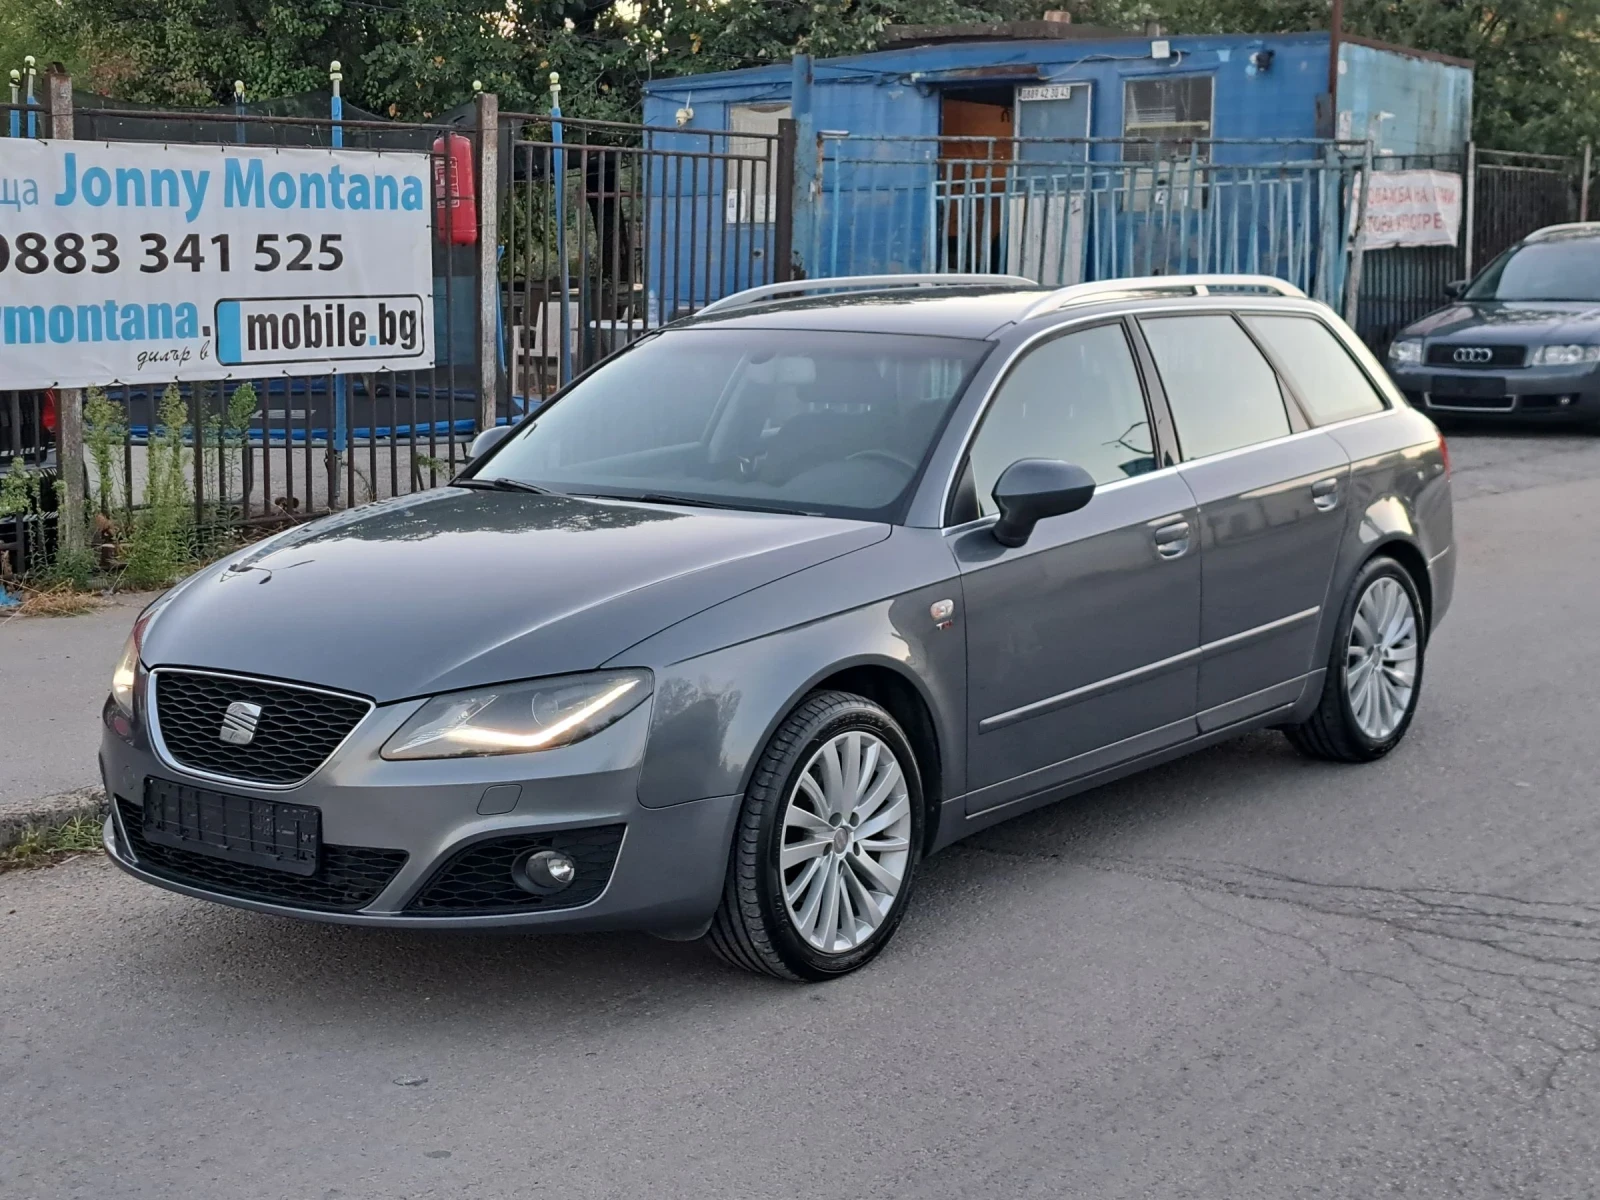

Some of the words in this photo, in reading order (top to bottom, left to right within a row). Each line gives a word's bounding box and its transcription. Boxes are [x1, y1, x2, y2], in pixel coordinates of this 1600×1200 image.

[54, 152, 211, 223] Jonny
[224, 157, 424, 211] Montana
[0, 232, 120, 275] 883
[139, 233, 230, 274] 341
[254, 233, 344, 272] 525
[0, 300, 211, 345] montana.
[247, 302, 416, 351] mobile.bg
